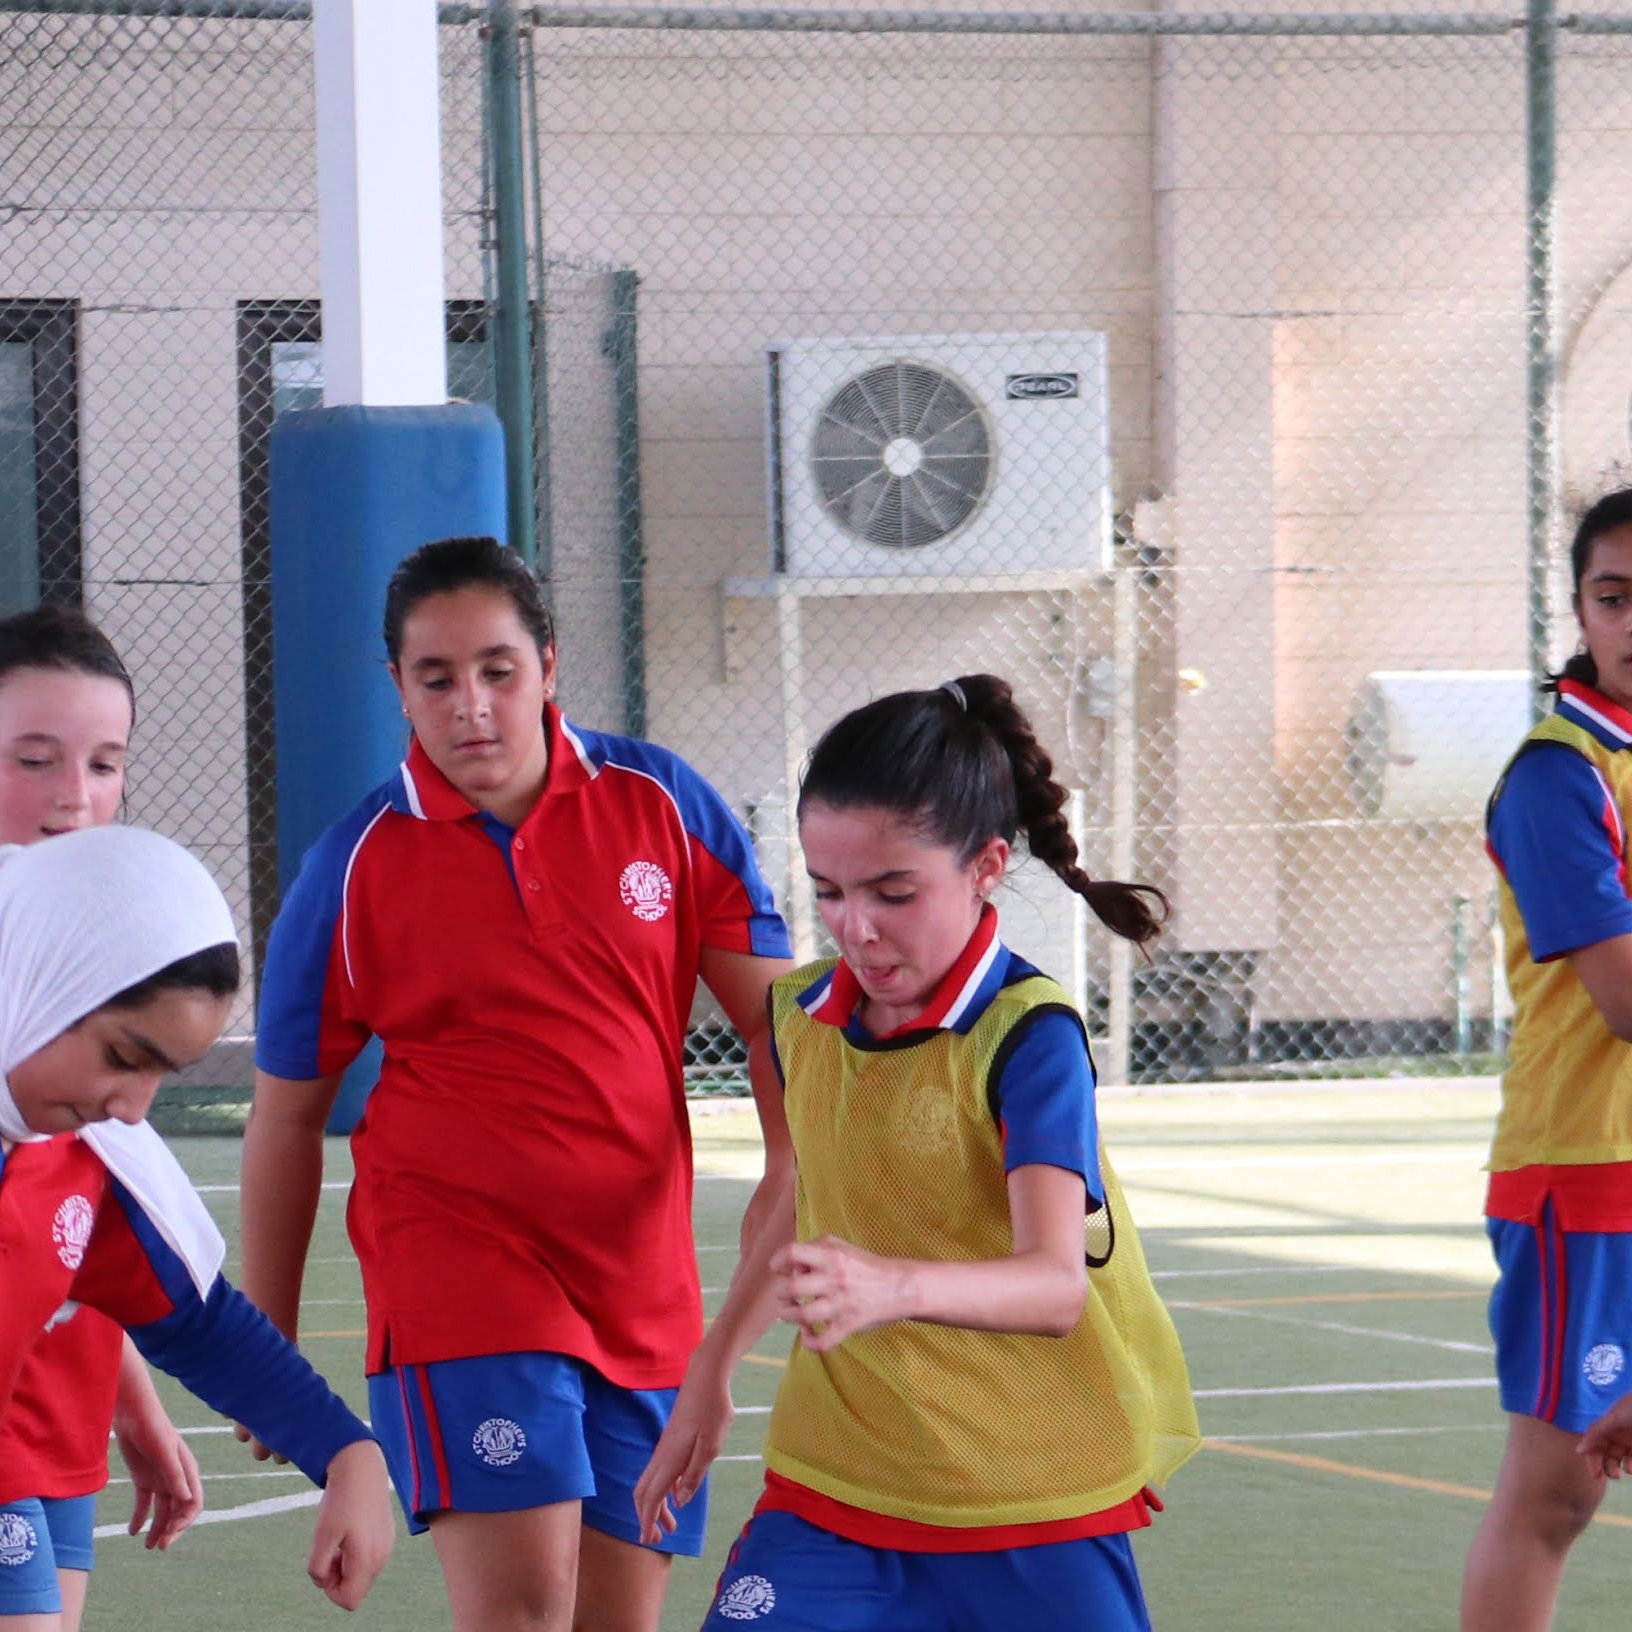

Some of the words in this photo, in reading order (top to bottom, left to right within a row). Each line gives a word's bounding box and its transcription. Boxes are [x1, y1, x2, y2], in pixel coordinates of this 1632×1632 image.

[1014, 380, 1068, 392] PEARL
[619, 861, 673, 900] CHRISTOPHER'S
[632, 904, 668, 922] SCHOOL
[472, 1418, 527, 1448] CHRISTOPHER'S
[482, 1449, 524, 1467] SCHOOL
